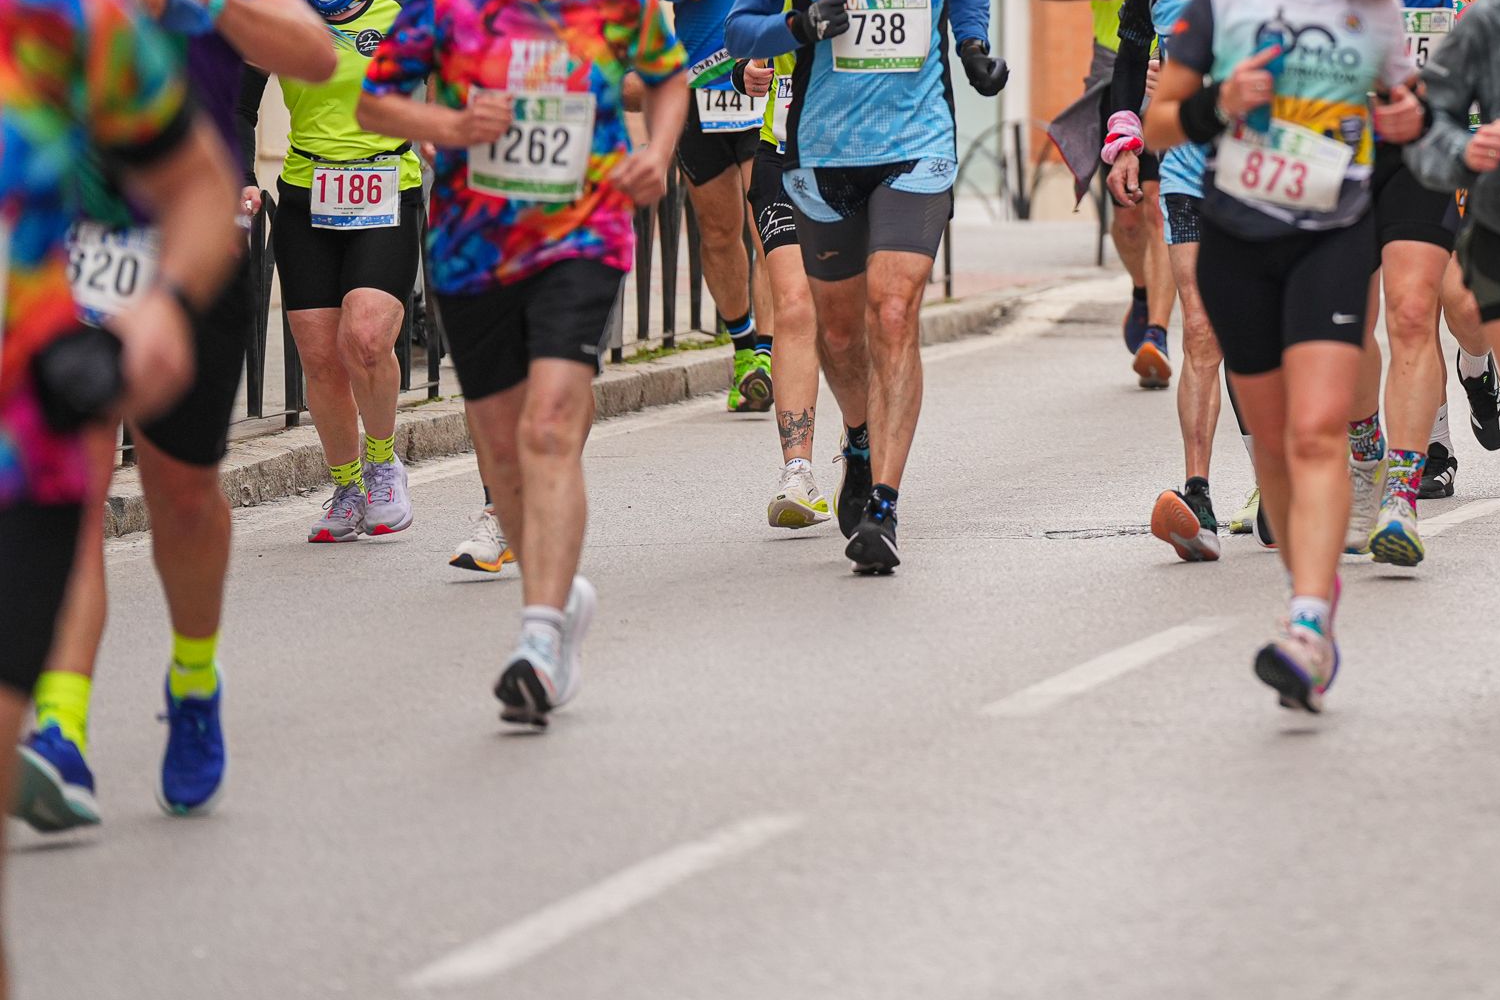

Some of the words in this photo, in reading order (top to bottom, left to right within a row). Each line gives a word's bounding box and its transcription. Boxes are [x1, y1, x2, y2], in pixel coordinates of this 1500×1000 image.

[852, 13, 905, 45] 738
[691, 58, 714, 75] Club
[317, 173, 382, 204] 1186
[1241, 149, 1308, 200] 873
